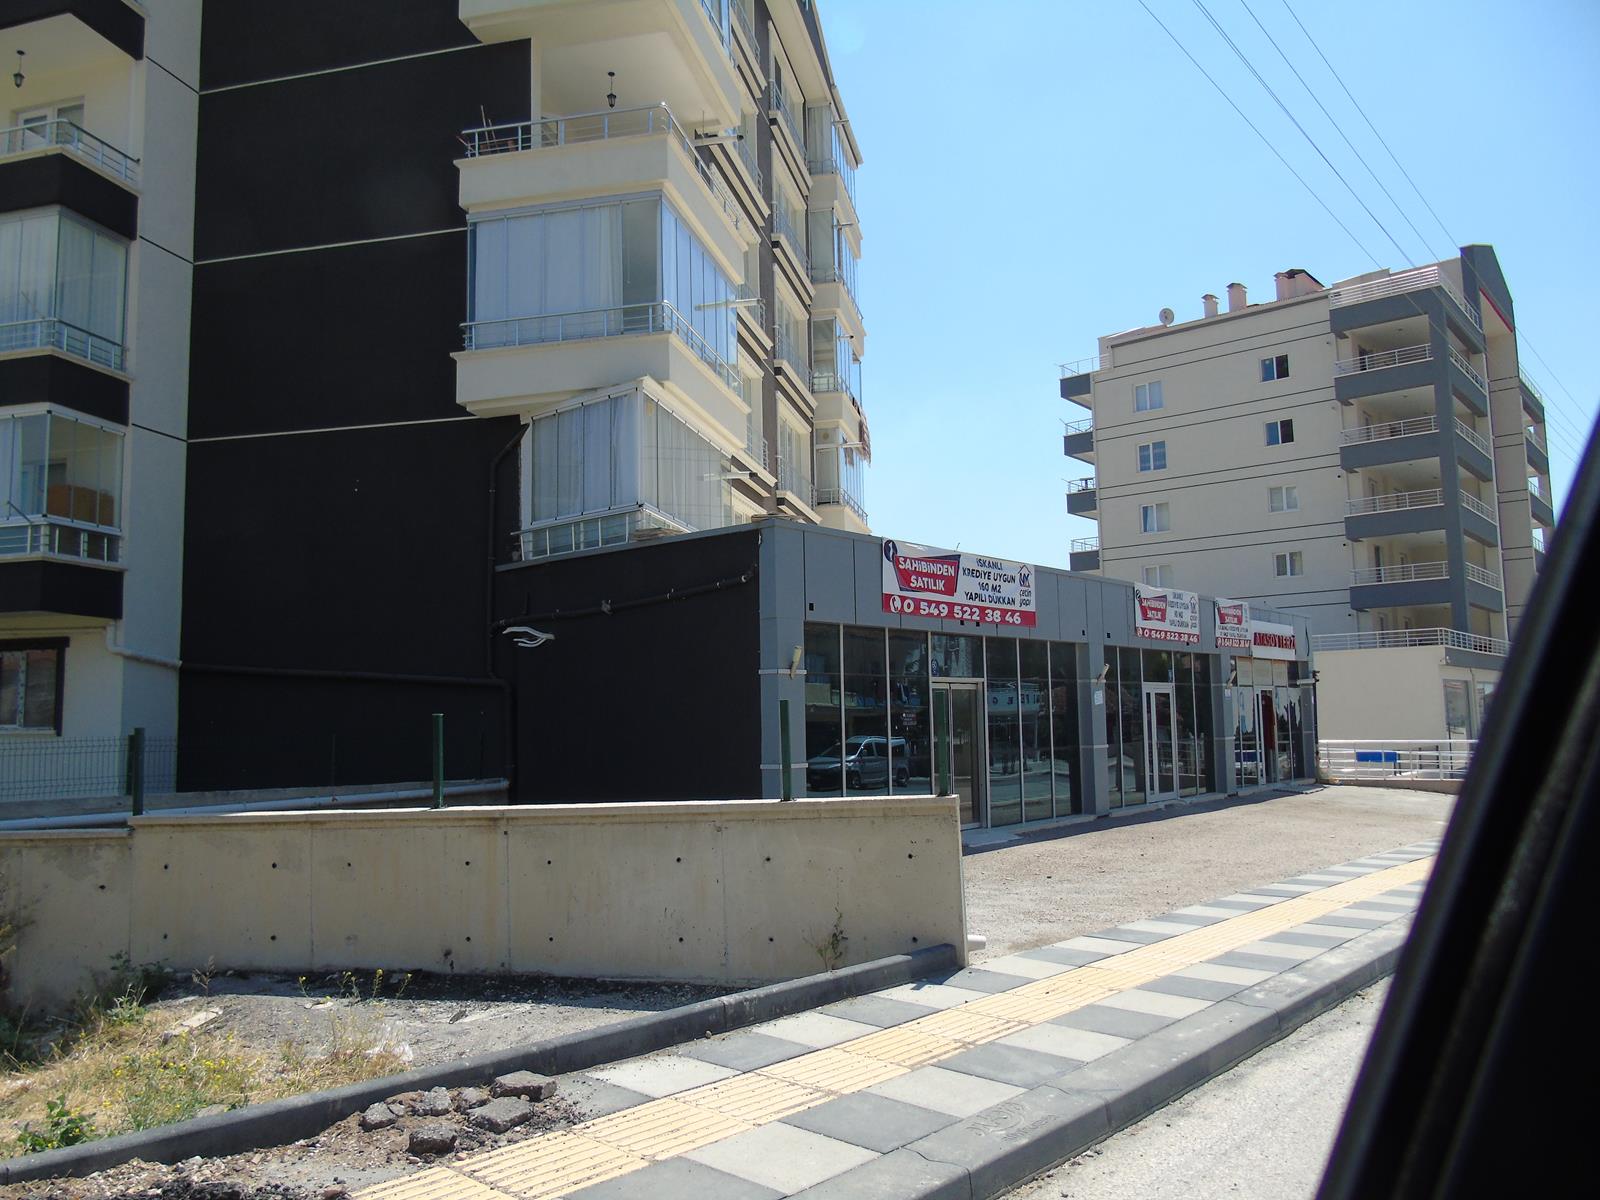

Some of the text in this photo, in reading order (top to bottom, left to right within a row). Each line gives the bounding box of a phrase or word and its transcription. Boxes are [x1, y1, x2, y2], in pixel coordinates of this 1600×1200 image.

[899, 557, 955, 577] SAHİBİNDEN
[976, 558, 1003, 571] İSKANLI
[962, 567, 991, 581] KREDİYE
[993, 571, 1016, 584] UYGUN
[910, 576, 945, 591] SATILIK
[991, 584, 1002, 594] M2
[964, 591, 1016, 606] YAPILI DÜKKAN
[903, 599, 1022, 624] 0 549 522 38 46
[1151, 630, 1165, 640] 549
[1165, 631, 1179, 641] 522
[1189, 634, 1199, 643] 46
